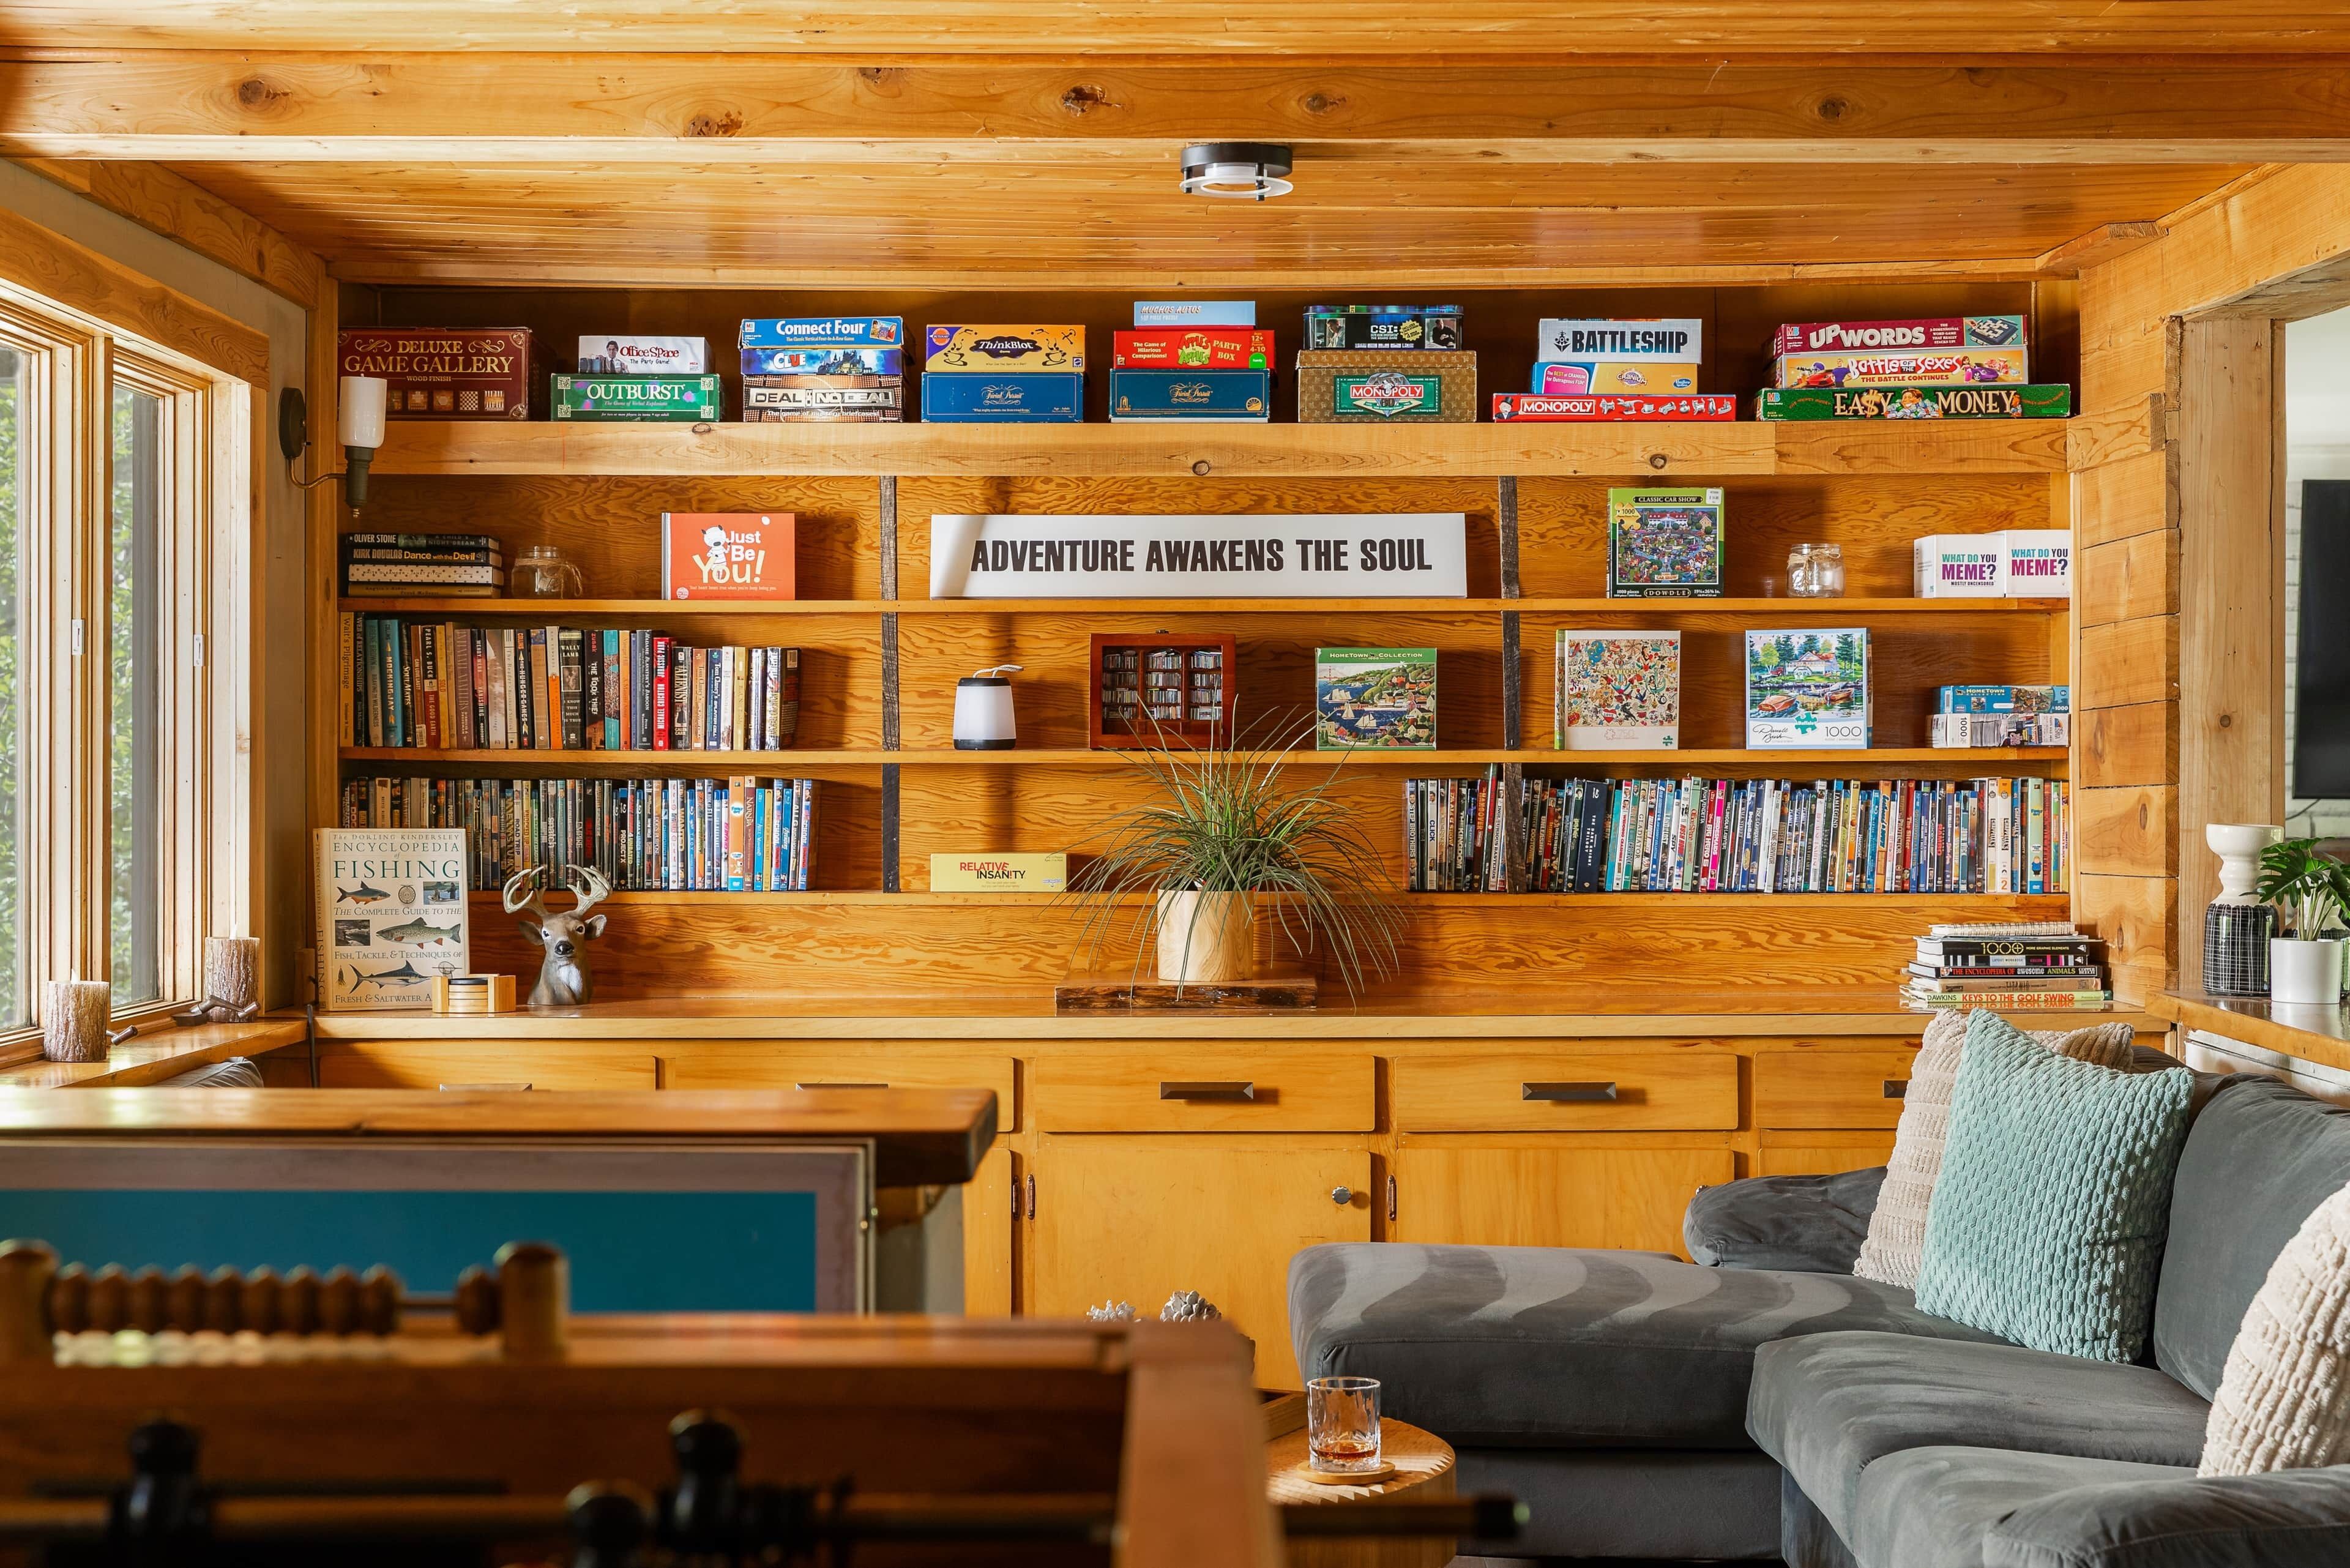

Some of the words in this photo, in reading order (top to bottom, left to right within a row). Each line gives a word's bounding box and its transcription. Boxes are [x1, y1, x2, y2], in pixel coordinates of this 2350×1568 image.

[776, 320, 832, 335] Connect
[835, 320, 866, 334] Four
[1370, 325, 1398, 334] CSI:
[1572, 330, 1688, 353] BATTLESHIP
[1810, 324, 1926, 348] UPWORDS
[398, 340, 463, 354] DELUXE
[1213, 340, 1242, 351] PARTY
[773, 353, 807, 369] CLUE
[1217, 351, 1235, 361] BOX
[345, 356, 409, 372] GAME
[413, 356, 514, 373] GALLERY
[1849, 358, 1898, 379] Battle
[587, 384, 685, 399] OUTBURST
[755, 393, 802, 403] DEAL
[816, 392, 841, 404] NO
[843, 392, 891, 404] DEAL
[1352, 386, 1422, 397] MONOPOLY
[1524, 401, 1594, 413] MONOPOLY
[1936, 390, 2018, 414] MONEY
[354, 534, 375, 543] OLIVER
[726, 531, 761, 543] Just
[354, 549, 370, 559] KIRK
[372, 550, 403, 559] DOUGLAS
[731, 545, 756, 562] Be
[971, 539, 1135, 572] ADVENTURE
[1146, 539, 1284, 572] AWAKENS
[1296, 539, 1349, 571] THE
[1360, 538, 1433, 570] SOUL
[1942, 554, 1966, 562] WHAT
[1968, 554, 1979, 562] DO
[1980, 554, 1996, 562] YOU
[2012, 548, 2037, 558] WHAT
[2038, 548, 2049, 557] DO
[2051, 548, 2068, 557] YOU
[692, 550, 766, 584] You!
[1942, 564, 1996, 580] MEME?
[2012, 558, 2068, 576] MEME?
[1825, 726, 1862, 737] 1000
[745, 797, 754, 827] NARNIA
[1477, 793, 1486, 830] HANGOVER
[548, 817, 556, 848] snatch
[1635, 813, 1644, 859] GLADIATOR
[333, 842, 460, 853] ENCYCLOPEDIA
[333, 860, 460, 879] FISHING
[960, 862, 1009, 871] RELATIVE
[2002, 881, 2007, 890] 2
[334, 907, 352, 916] THE
[354, 907, 399, 916] COMPLETE
[402, 906, 430, 916] GUIDE
[334, 951, 354, 960] FISH,
[399, 949, 451, 958] TECHNIQUES
[335, 995, 363, 1003] FRESH
[365, 993, 373, 1002] &
[374, 994, 422, 1002] SALTWATER
